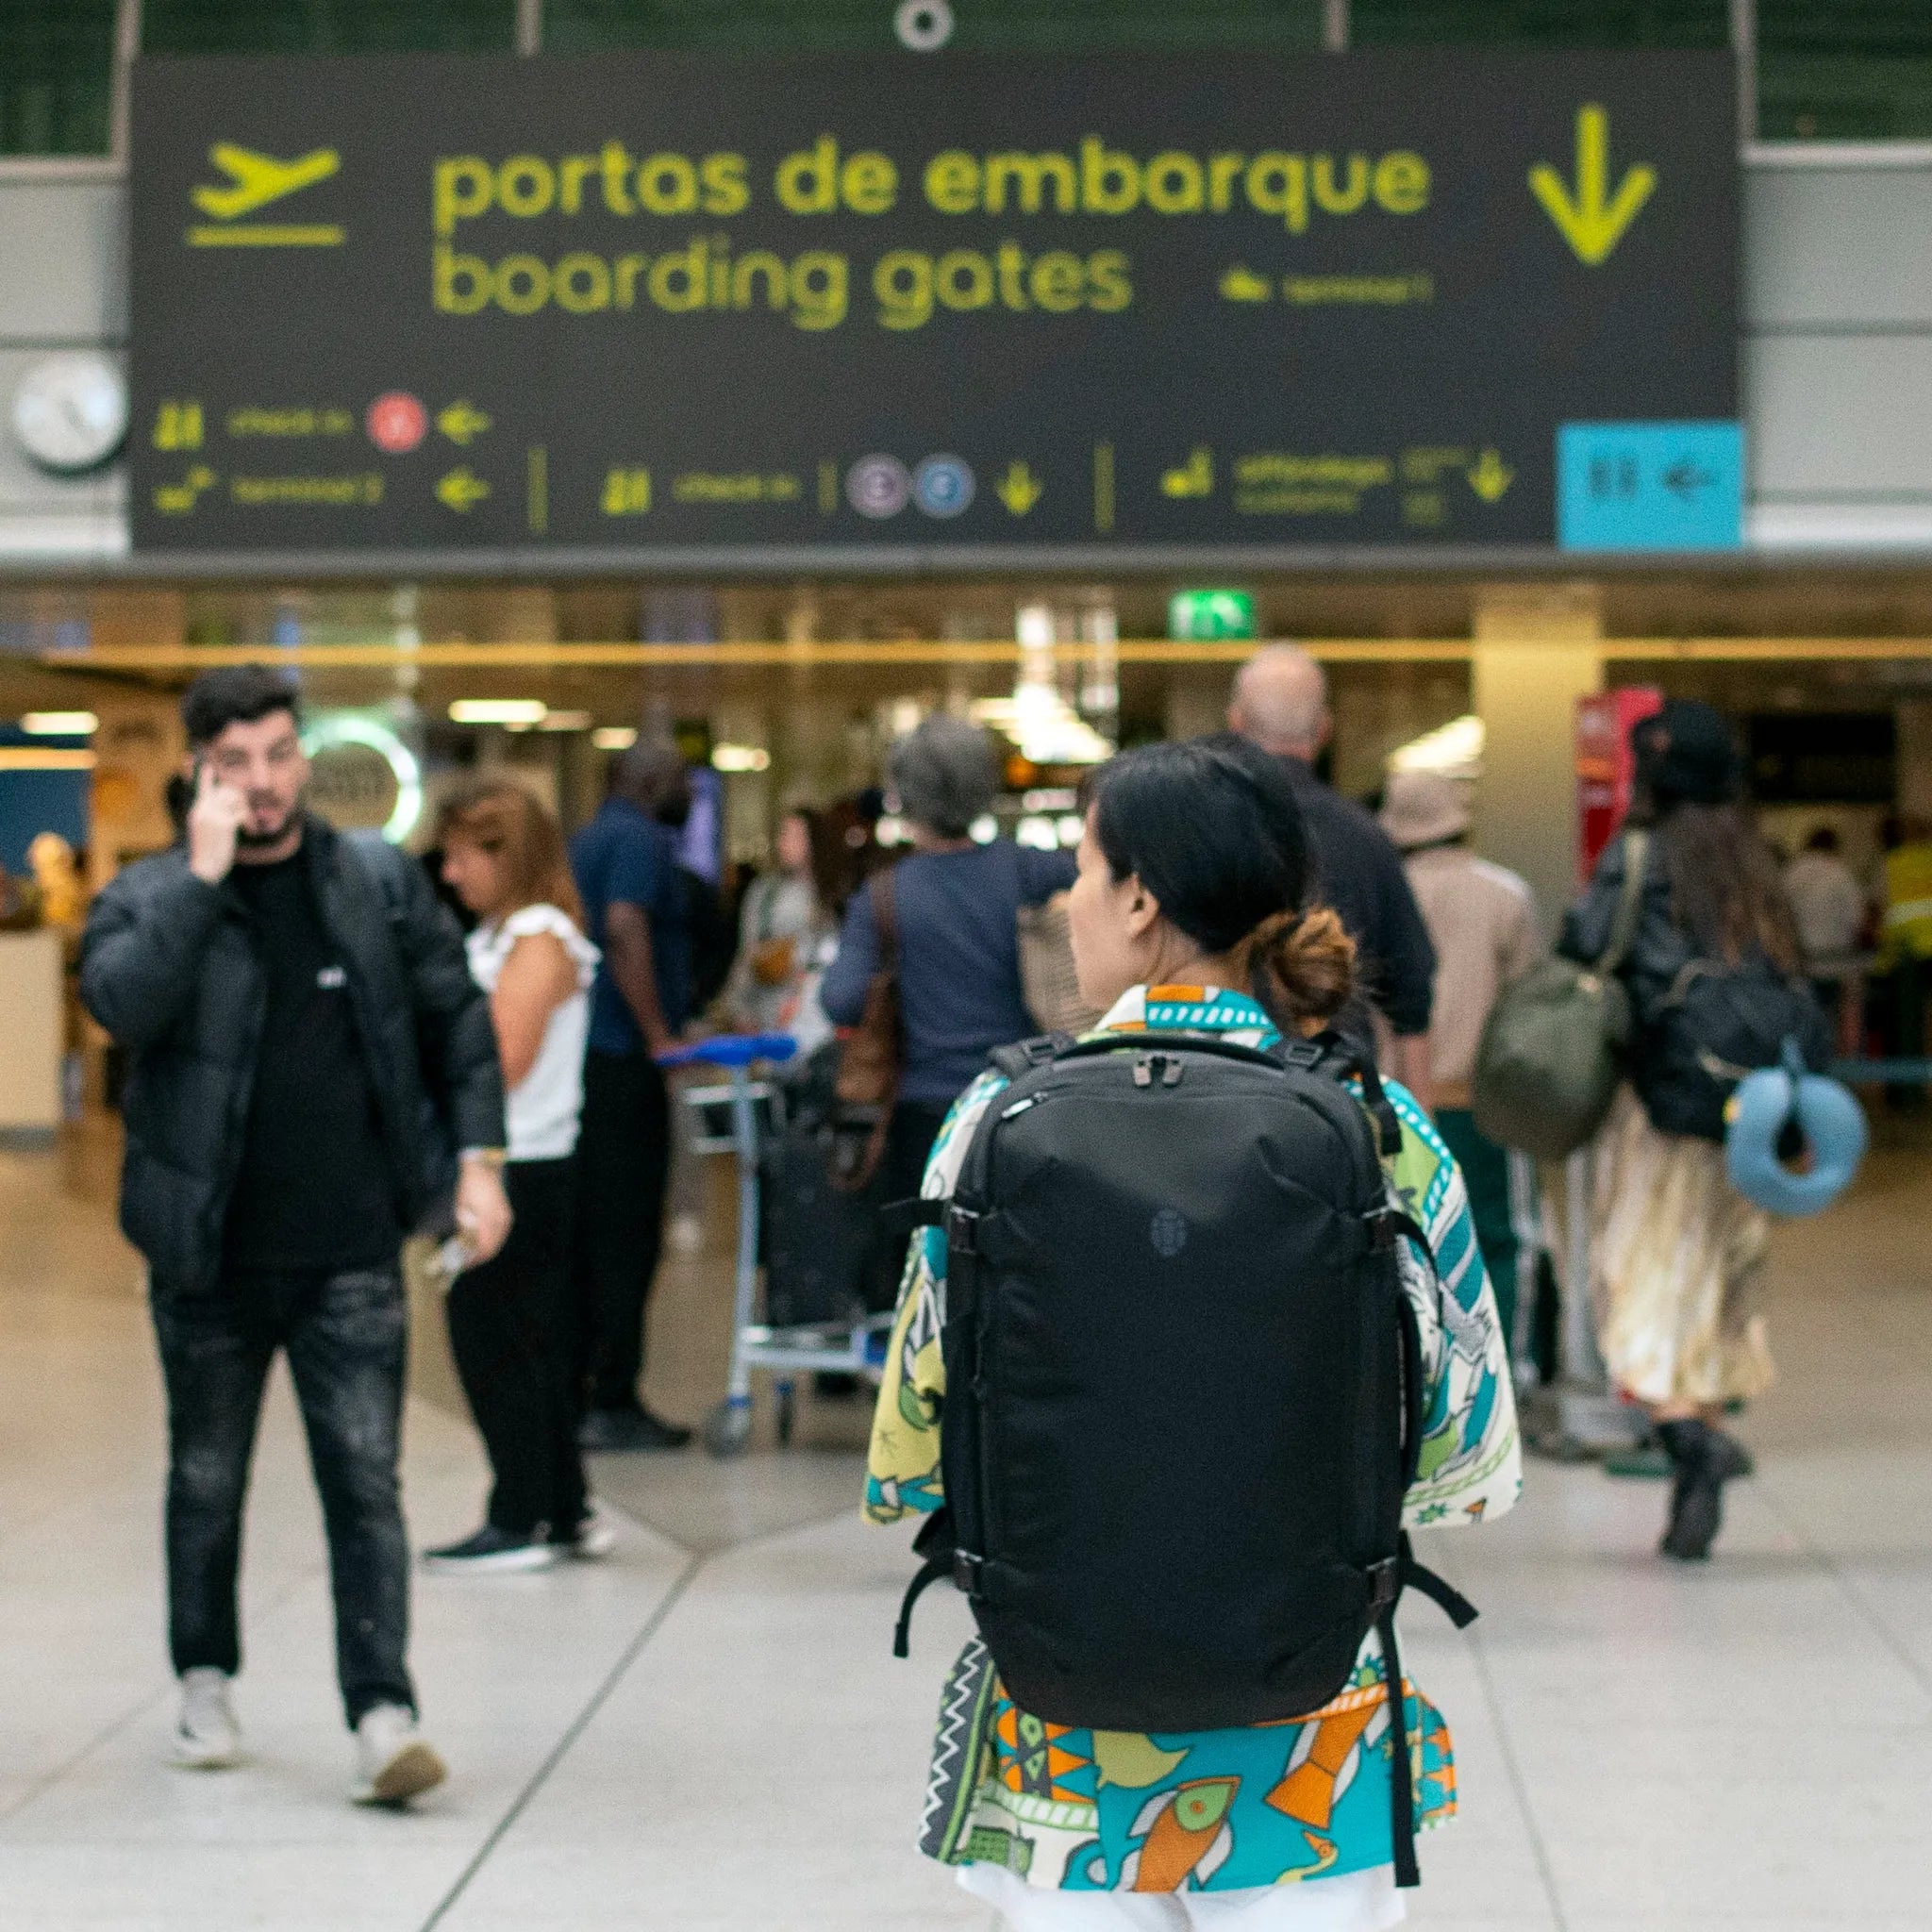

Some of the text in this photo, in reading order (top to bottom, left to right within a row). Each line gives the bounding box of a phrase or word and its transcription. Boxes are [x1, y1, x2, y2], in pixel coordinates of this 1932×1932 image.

[434, 138, 1429, 233] portas de embarque
[433, 238, 1131, 330] boarding gates
